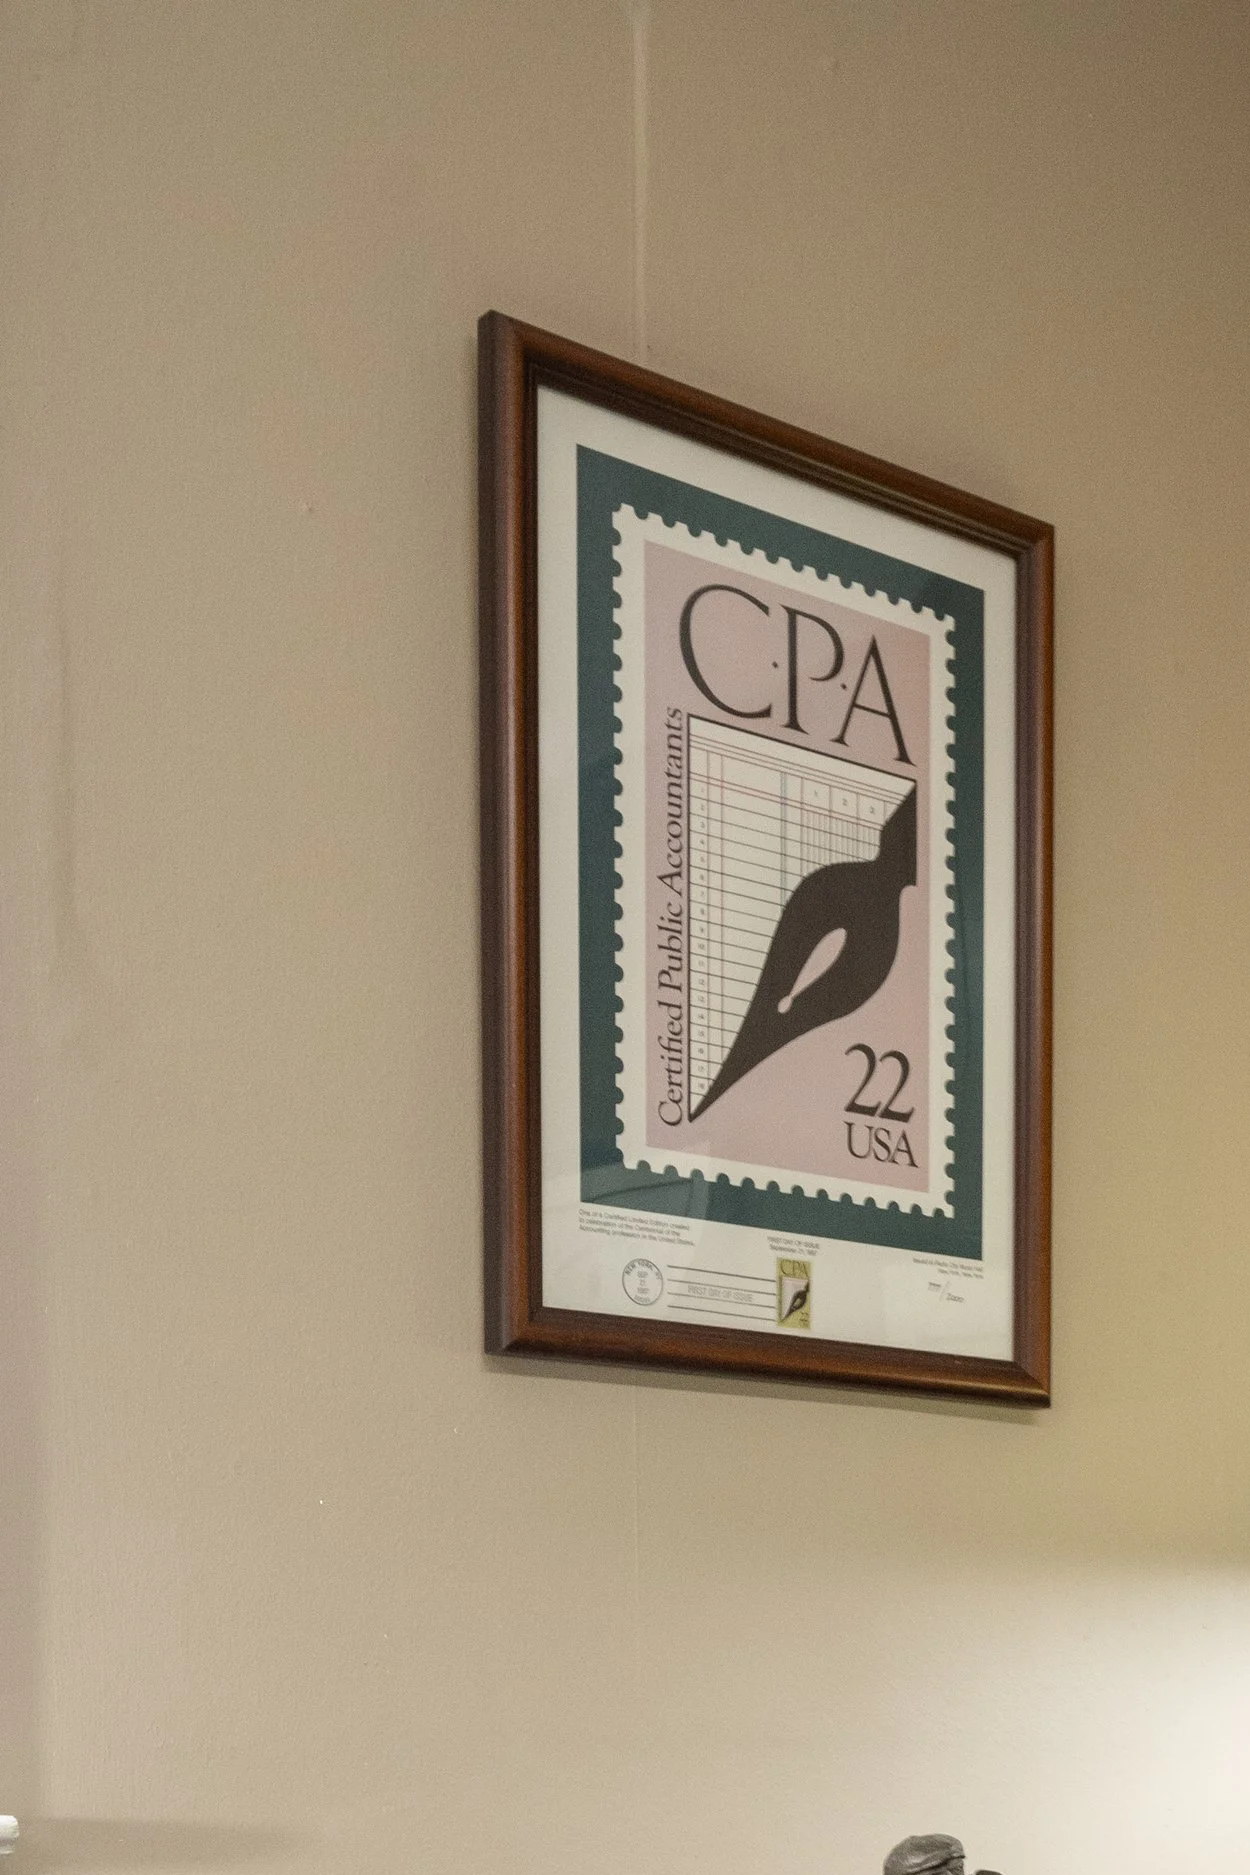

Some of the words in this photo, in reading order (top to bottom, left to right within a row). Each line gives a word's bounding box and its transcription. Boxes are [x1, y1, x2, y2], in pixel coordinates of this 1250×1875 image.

[656, 706, 683, 896] Accountants
[657, 904, 683, 992] Public
[657, 1000, 683, 1128] Certified
[844, 1043, 915, 1122] 22
[843, 1122, 918, 1168] USA
[780, 1258, 809, 1278] CPA
